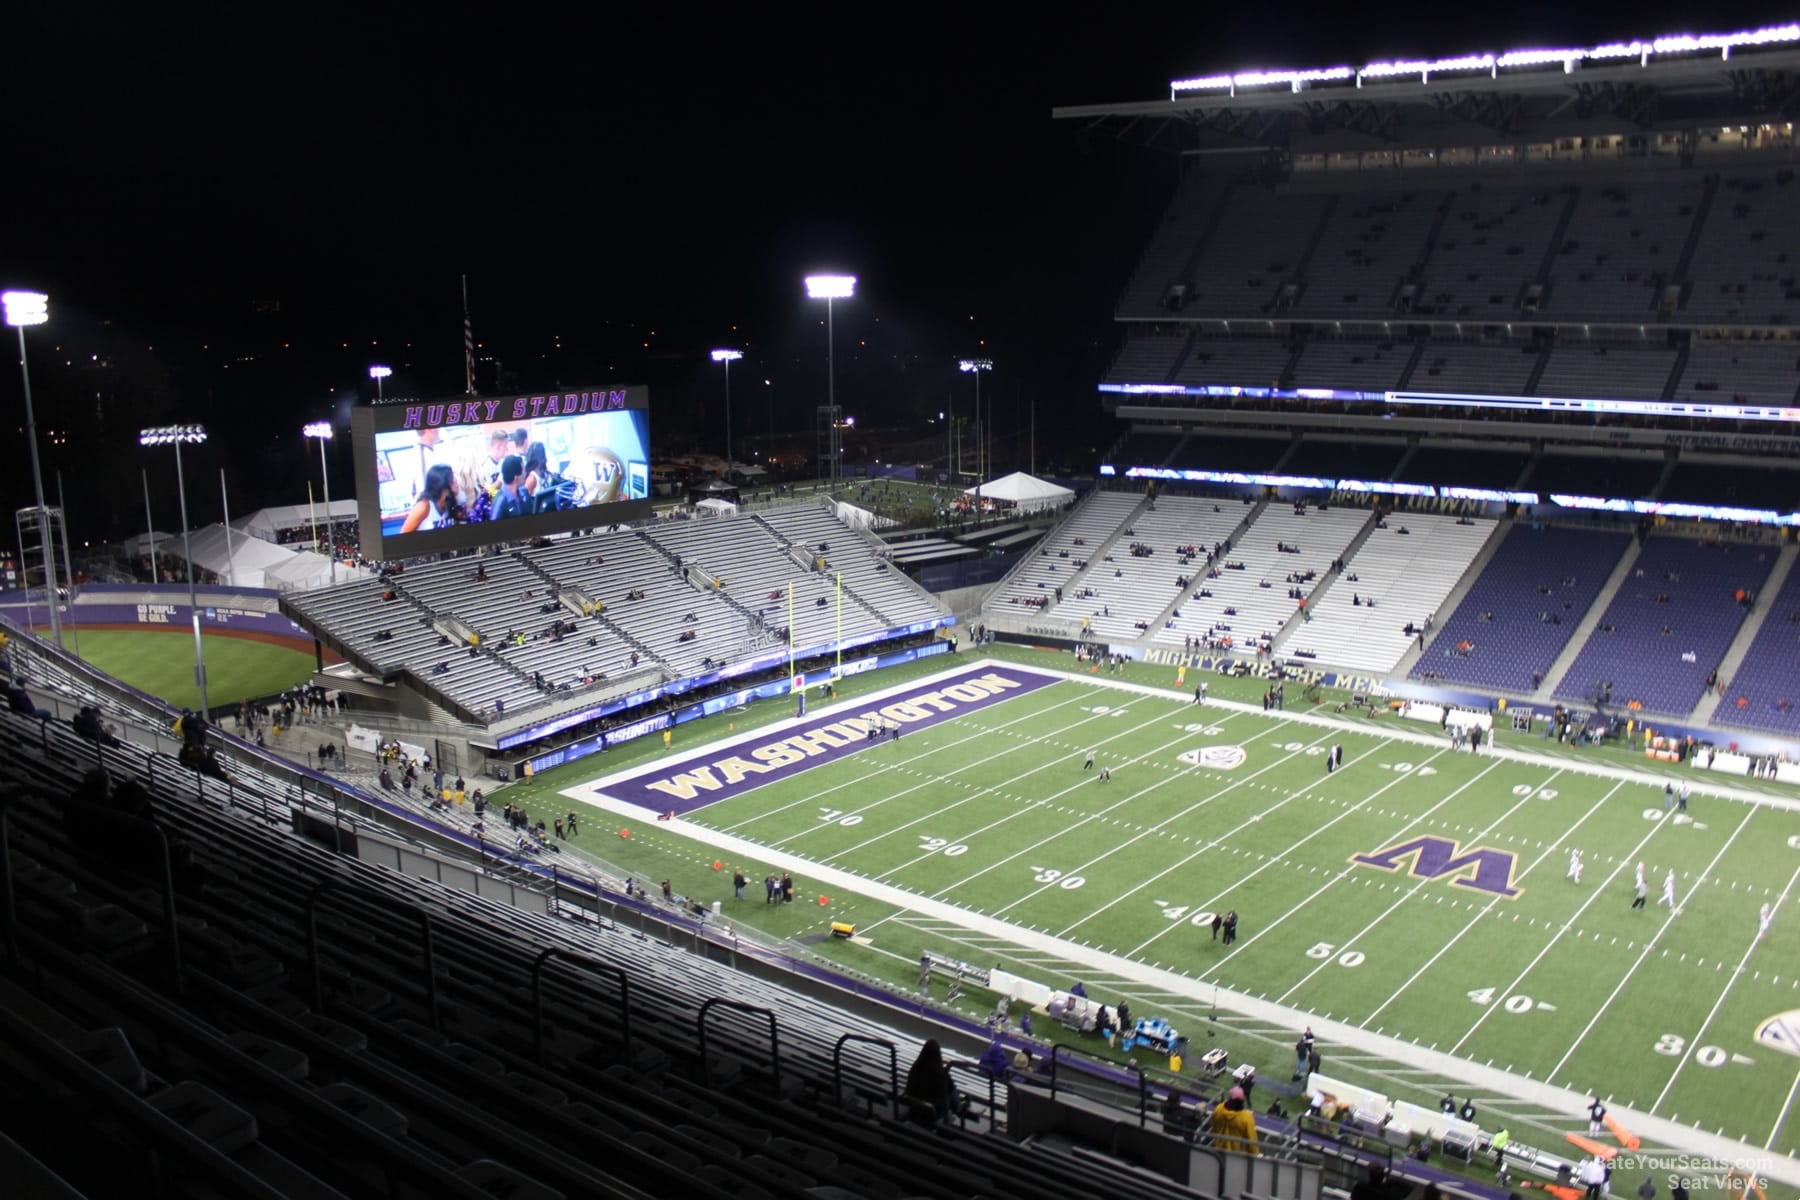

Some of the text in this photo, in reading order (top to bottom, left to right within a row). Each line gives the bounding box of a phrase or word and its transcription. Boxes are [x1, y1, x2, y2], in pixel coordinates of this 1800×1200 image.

[403, 390, 626, 428] HUSKY STADIUM
[593, 462, 615, 483] W
[1143, 647, 1222, 672] MIGHTY
[1334, 673, 1384, 695] MEN
[645, 673, 1022, 800] WASHINGTON
[817, 808, 863, 826] 10
[918, 837, 969, 856] 20
[1034, 869, 1086, 889] 30
[1346, 834, 1526, 901] W
[1161, 906, 1217, 926] 40
[1305, 941, 1365, 967] 50
[1467, 987, 1533, 1014] 40
[1654, 1033, 1728, 1068] 30
